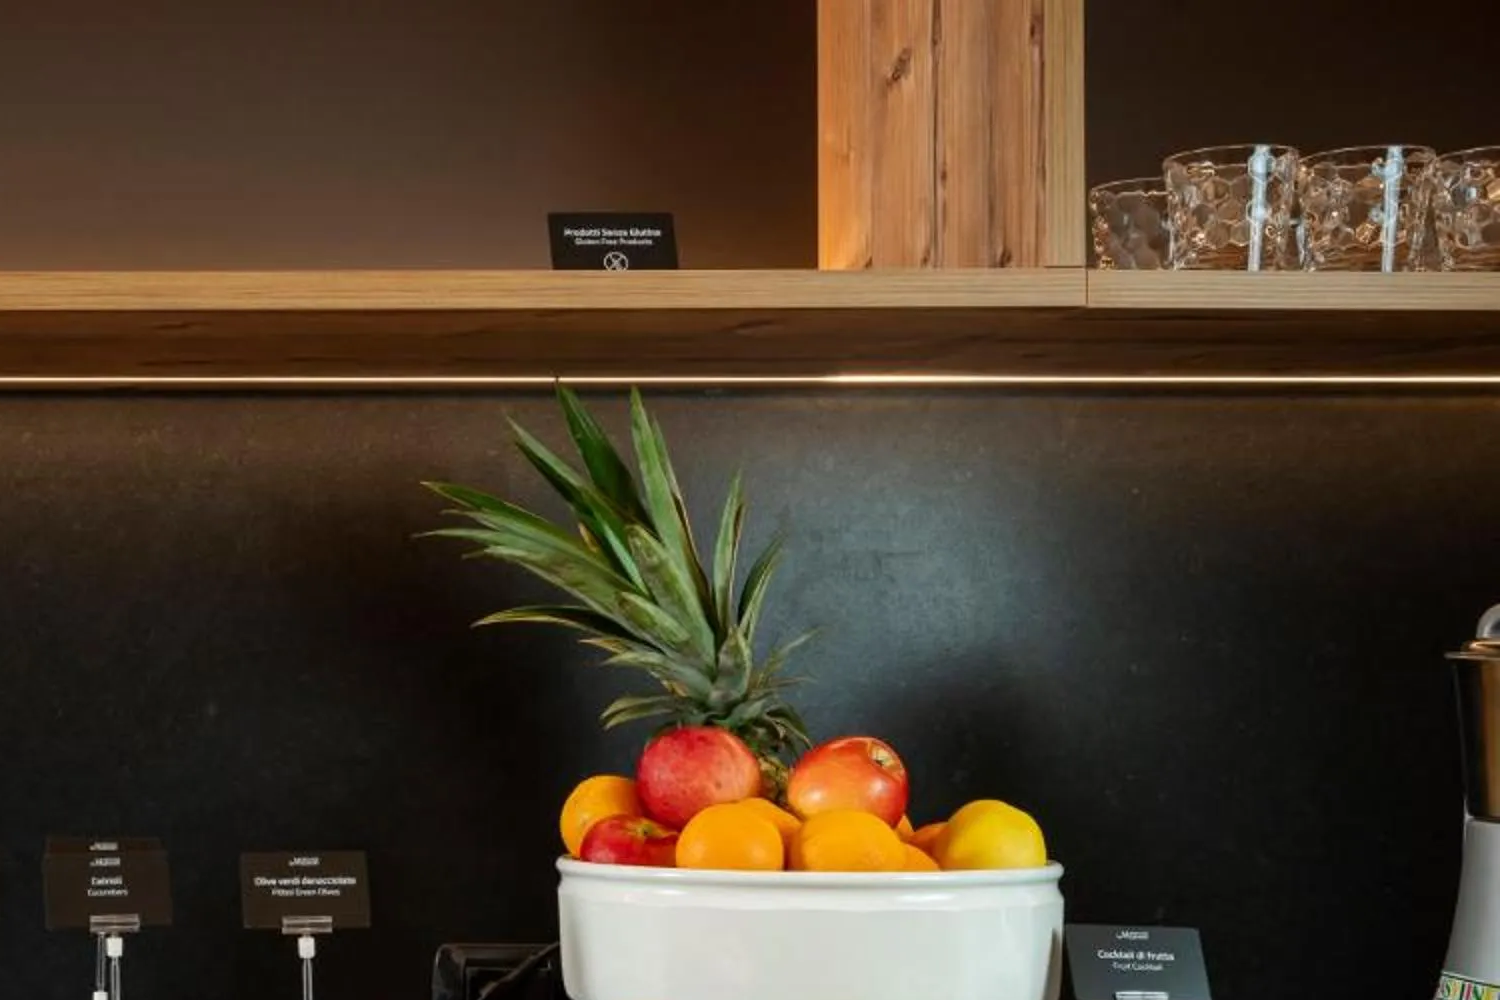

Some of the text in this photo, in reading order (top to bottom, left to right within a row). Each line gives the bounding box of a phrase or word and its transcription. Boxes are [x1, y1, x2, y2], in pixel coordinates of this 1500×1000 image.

[564, 227, 600, 236] Prodotti
[602, 228, 628, 236] Senza
[254, 877, 276, 885] Olive
[1097, 949, 1134, 959] Cocktail
